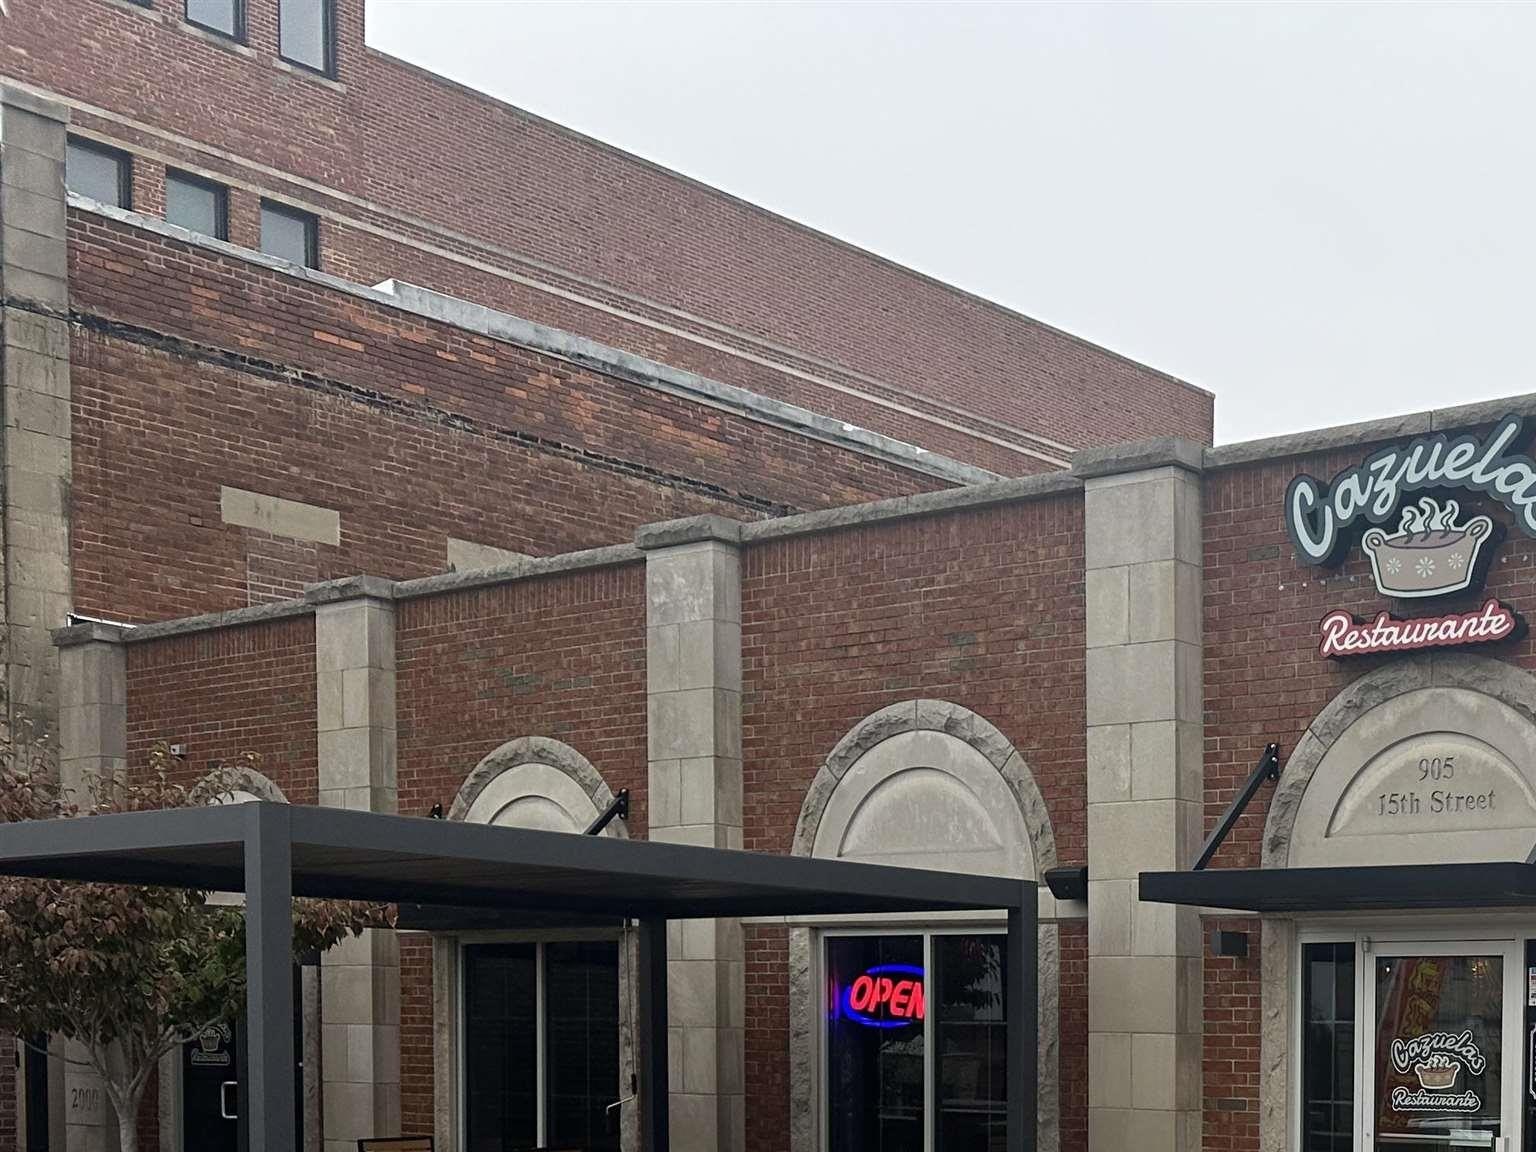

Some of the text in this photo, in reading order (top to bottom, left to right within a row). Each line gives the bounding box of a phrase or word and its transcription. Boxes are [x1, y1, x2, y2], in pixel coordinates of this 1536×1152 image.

[1321, 602, 1514, 656] Restaurante
[1418, 758, 1454, 781] 905
[1378, 790, 1495, 815] 15th Street
[1393, 1031, 1484, 1071] Cazuelas
[1393, 1089, 1479, 1107] Restaurante
